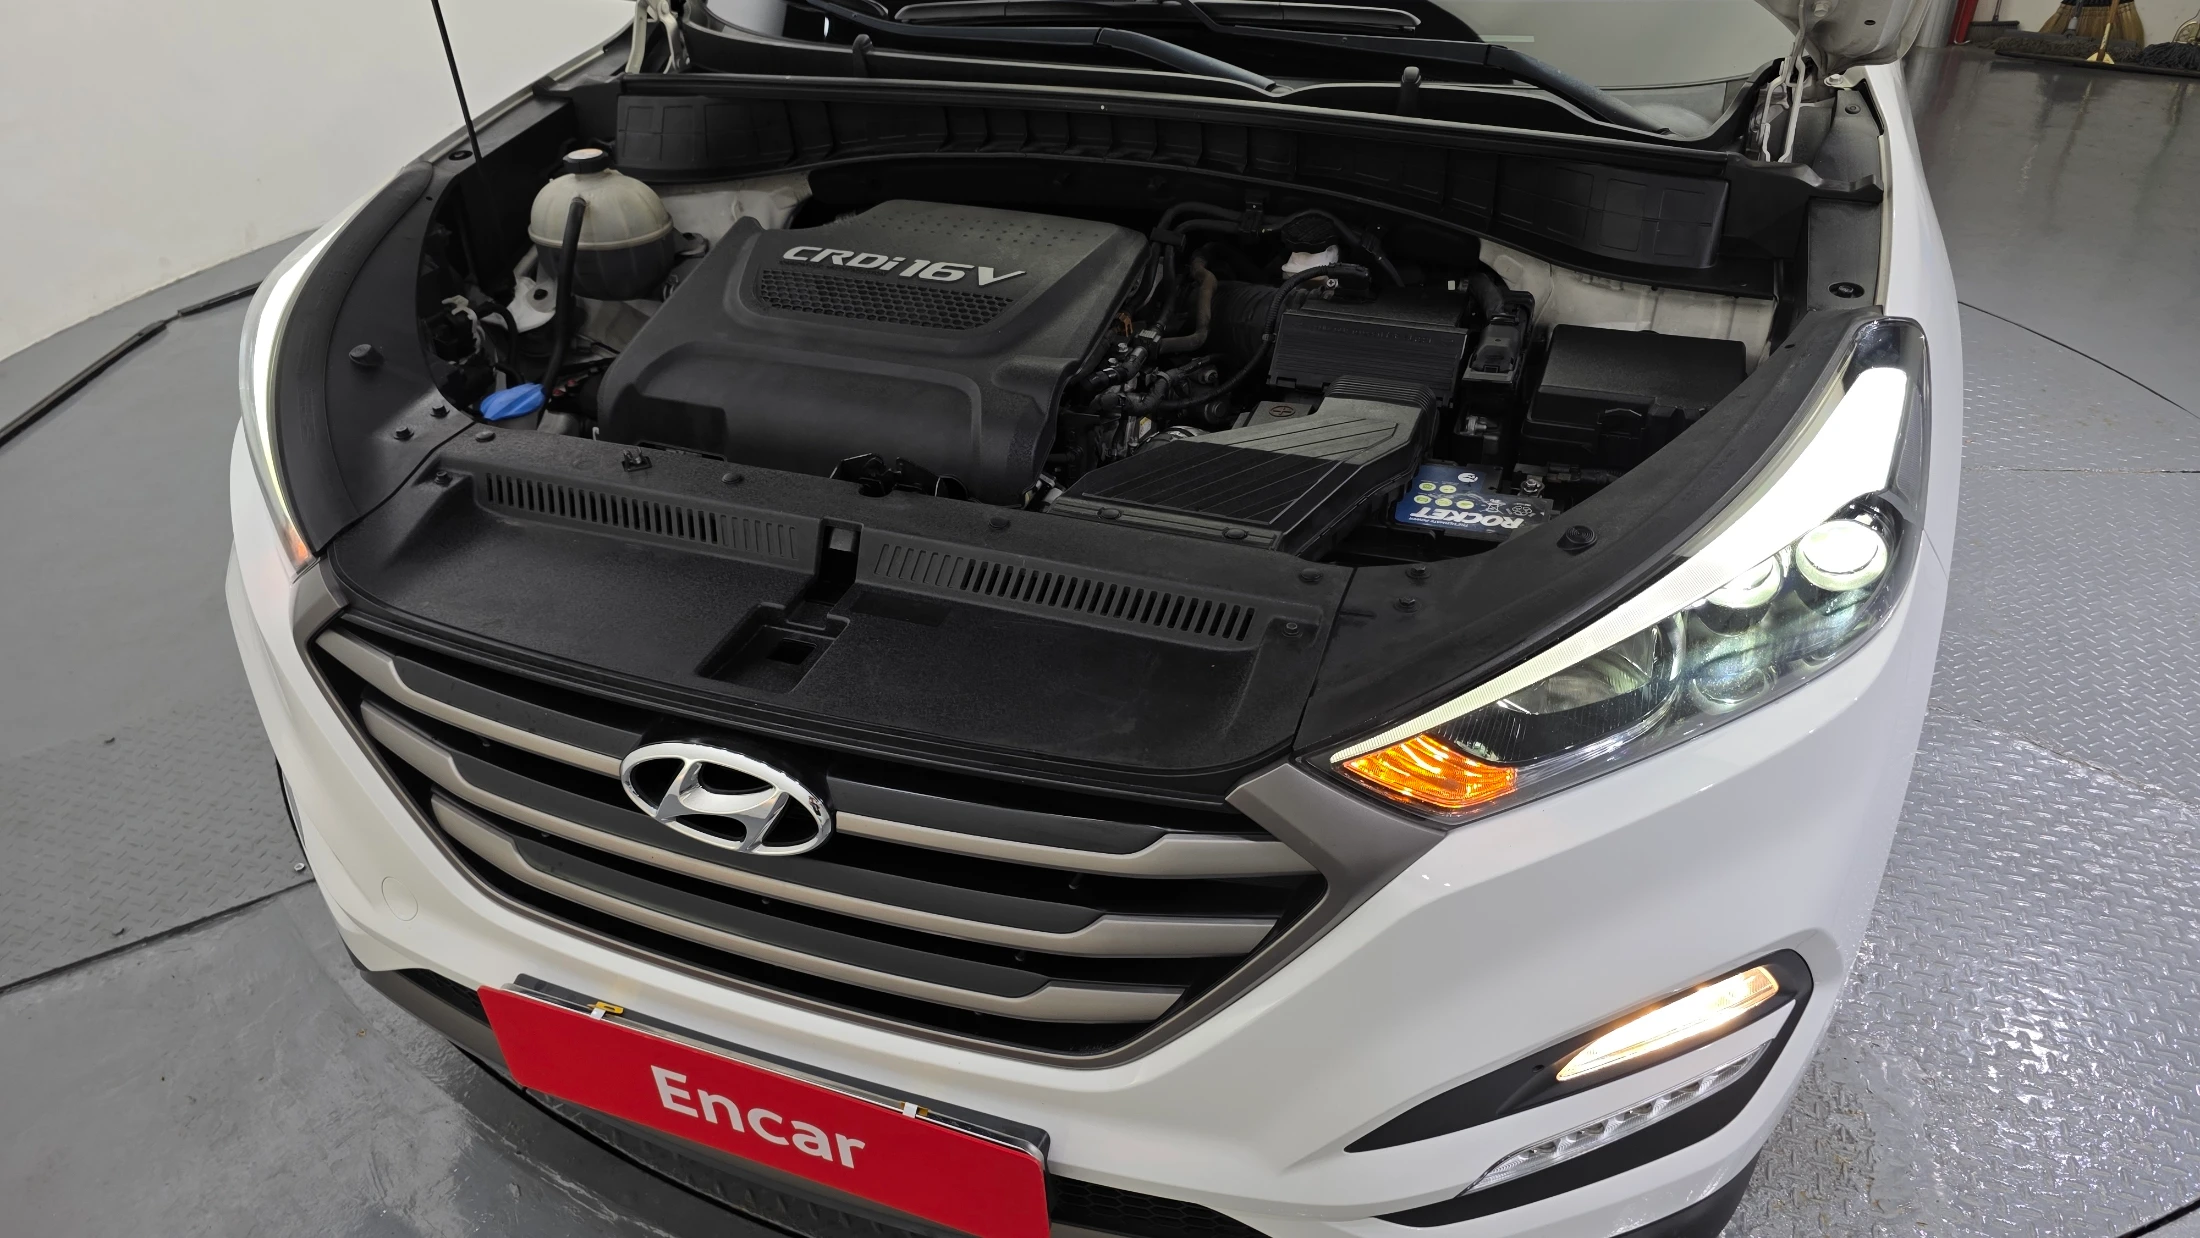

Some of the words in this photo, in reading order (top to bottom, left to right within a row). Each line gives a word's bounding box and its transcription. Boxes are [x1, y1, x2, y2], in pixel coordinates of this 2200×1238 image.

[783, 246, 906, 271] CRDi
[899, 259, 1026, 286] 16V
[1410, 507, 1524, 529] ROCKET
[651, 1065, 865, 1169] Encar
